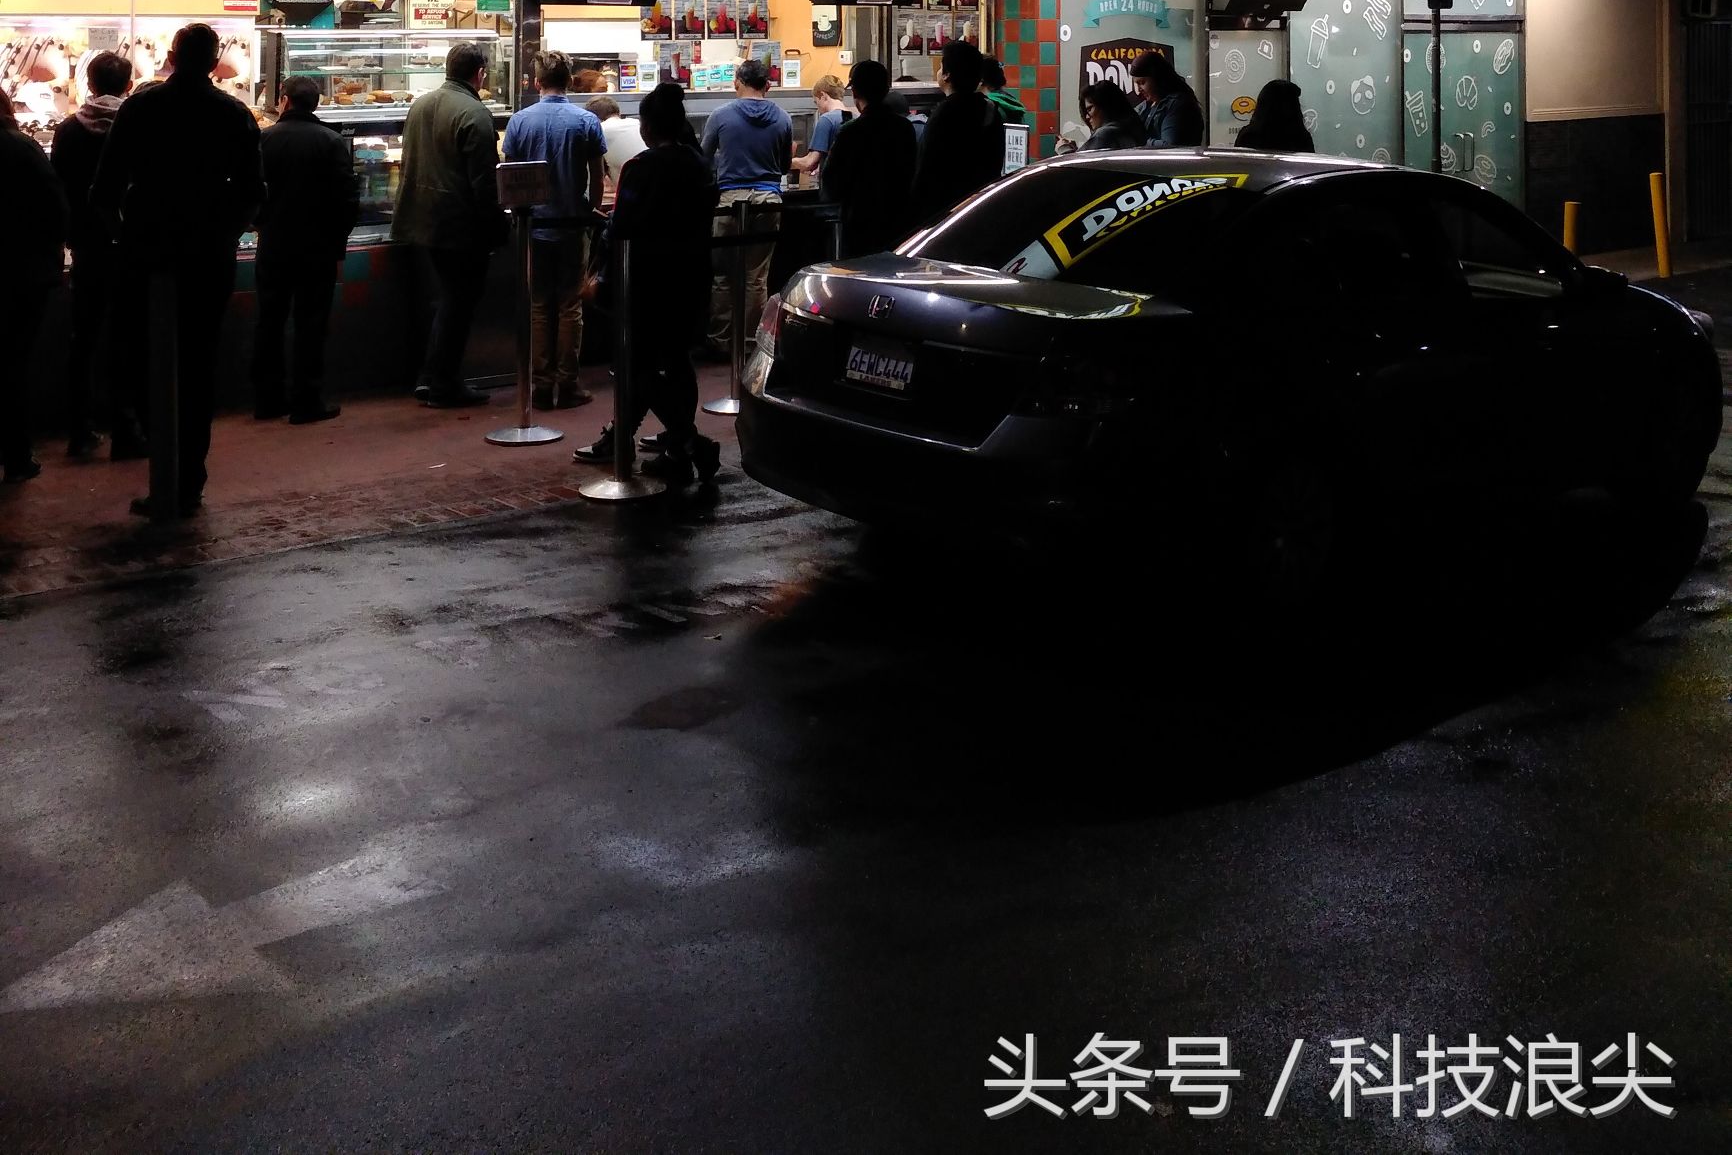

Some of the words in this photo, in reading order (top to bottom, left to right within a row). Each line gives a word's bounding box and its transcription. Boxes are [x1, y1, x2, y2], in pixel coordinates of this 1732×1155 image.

[1100, 0, 1117, 12] OPEN
[1137, 0, 1158, 14] HOURS
[1007, 135, 1024, 146] LINE
[1007, 151, 1023, 164] HERE
